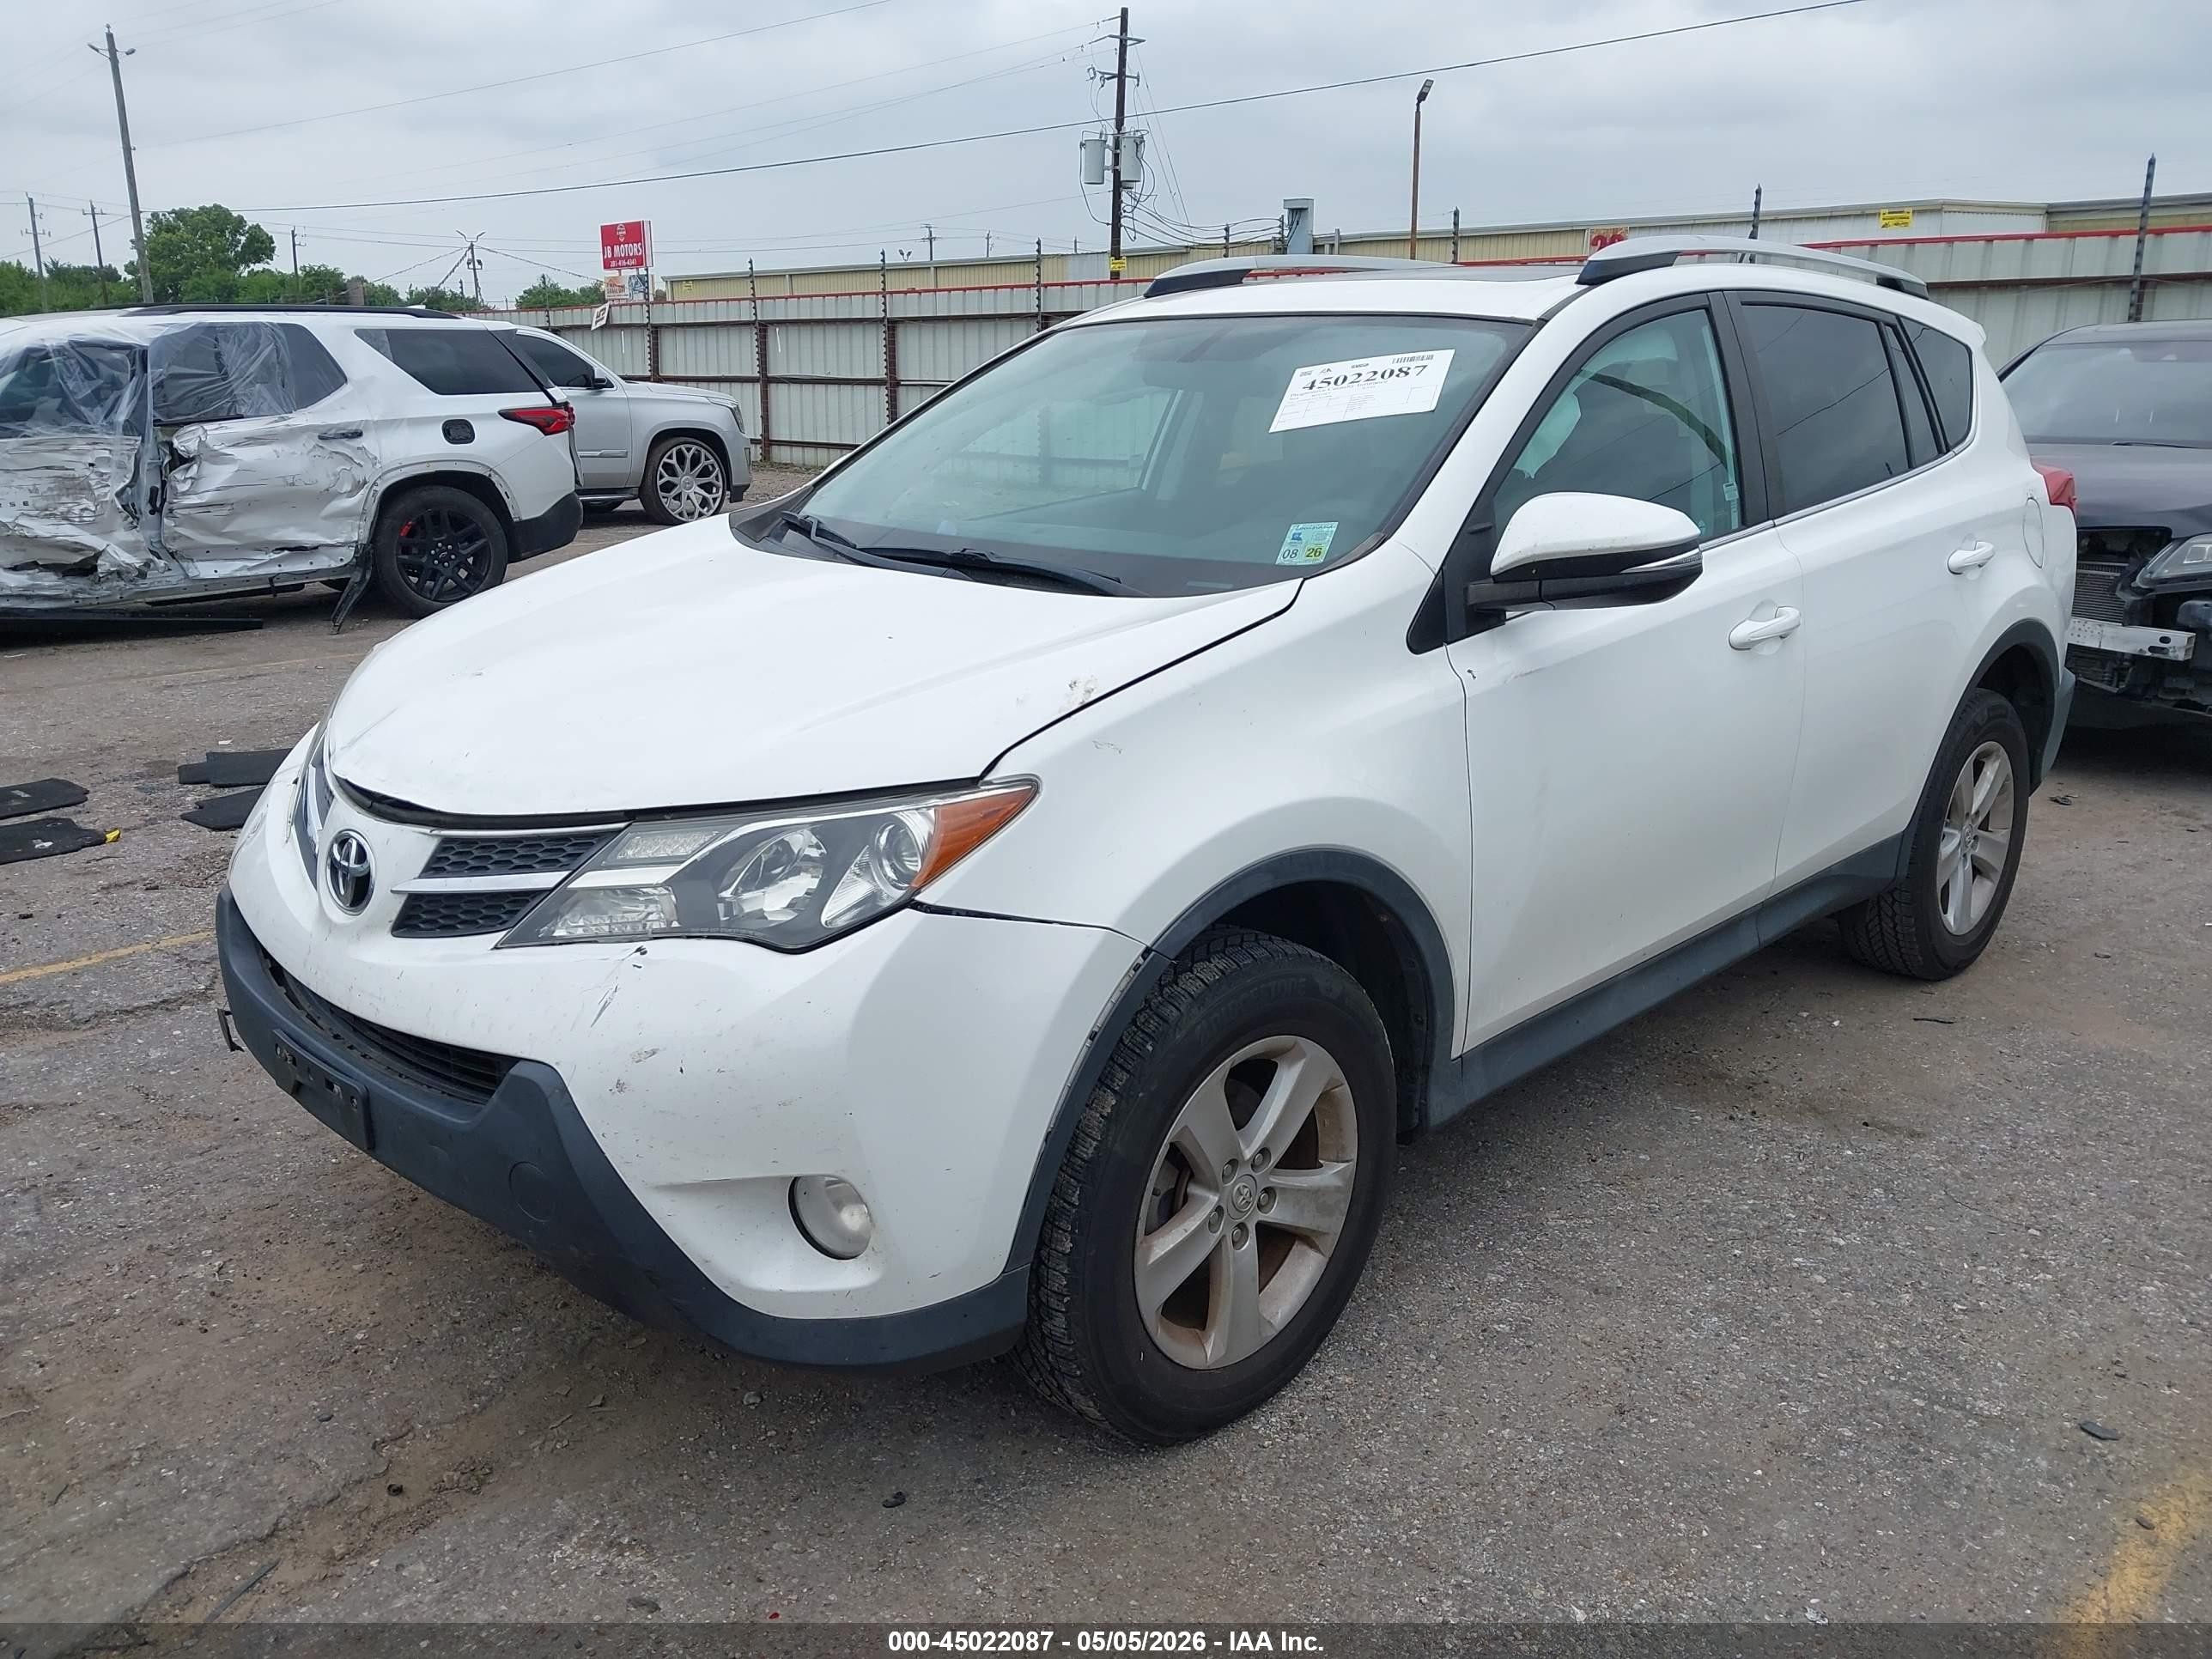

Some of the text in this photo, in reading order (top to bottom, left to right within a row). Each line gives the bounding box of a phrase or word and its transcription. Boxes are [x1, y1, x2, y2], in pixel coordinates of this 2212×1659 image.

[604, 242, 642, 259] JB MOTORS
[1302, 364, 1428, 391] 45022087
[1282, 547, 1322, 559] 08 26
